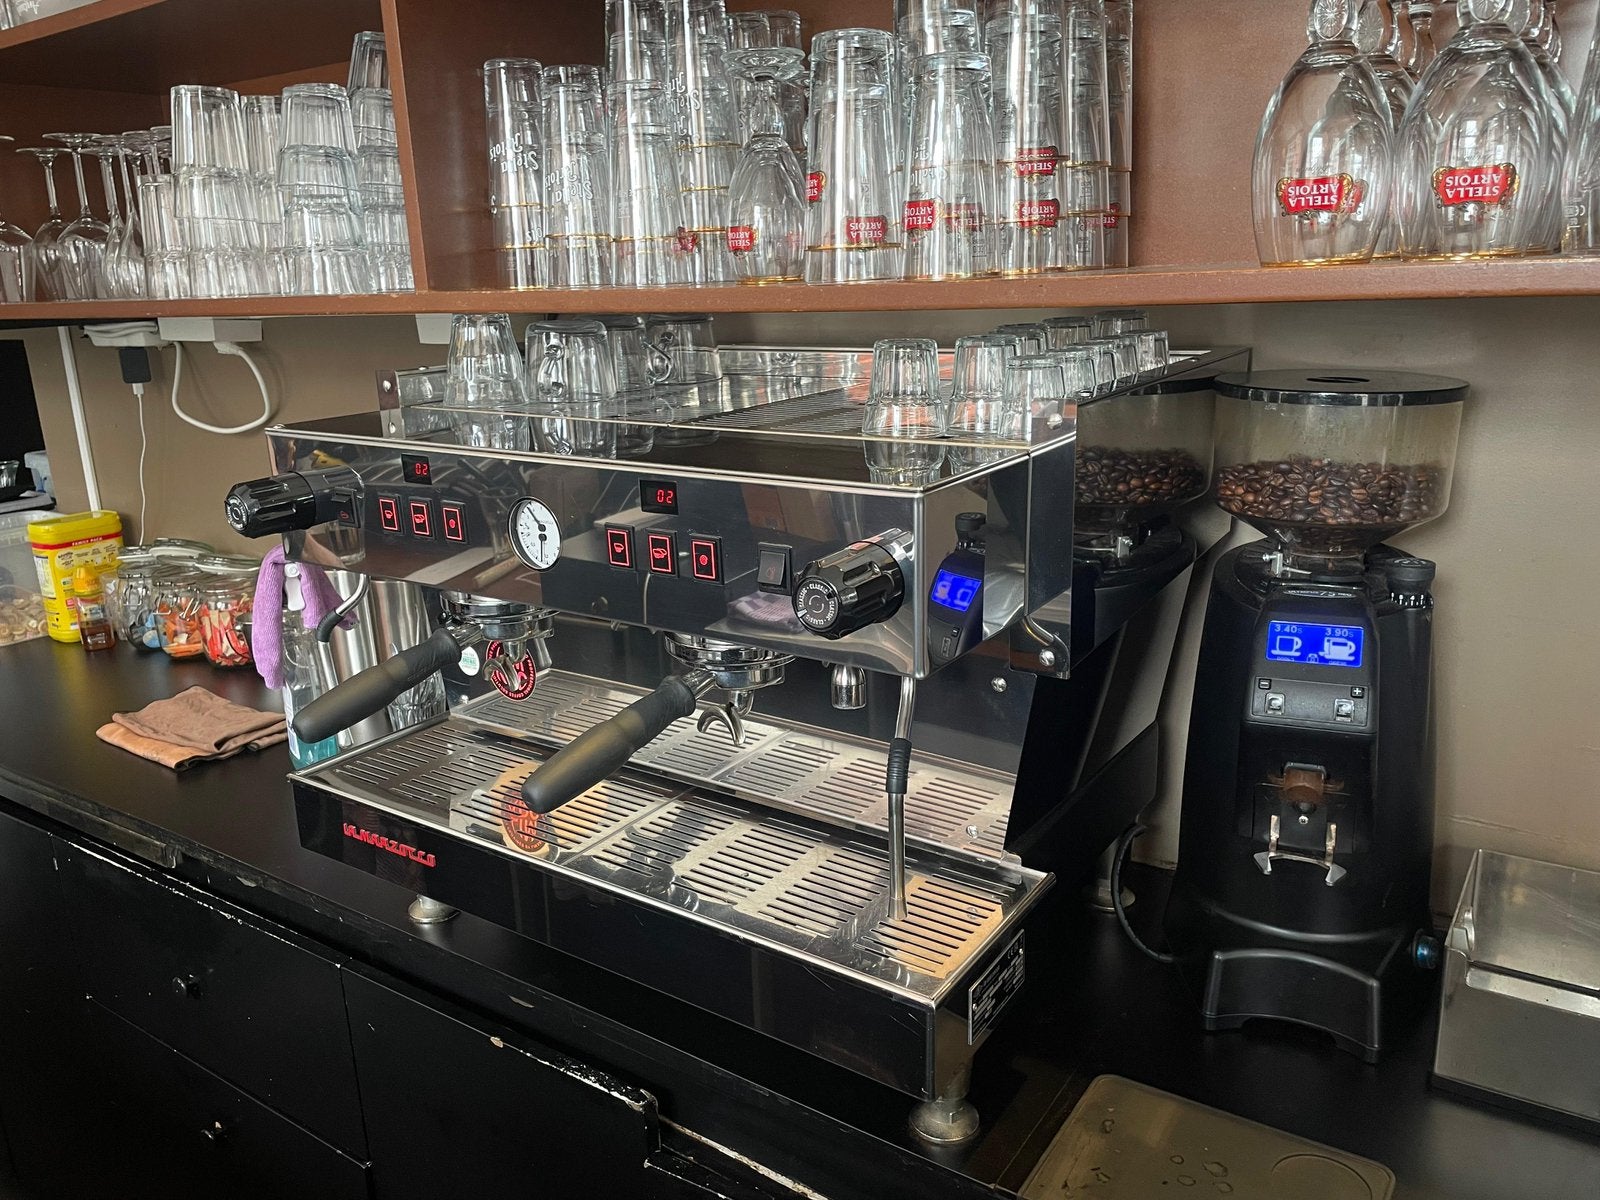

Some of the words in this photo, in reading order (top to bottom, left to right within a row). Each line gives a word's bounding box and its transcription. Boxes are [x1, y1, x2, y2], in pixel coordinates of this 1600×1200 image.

[489, 132, 523, 161] Atois
[500, 151, 539, 173] Stela
[1019, 162, 1053, 171] STELLA
[1445, 172, 1502, 187] ARTOIS
[1287, 181, 1340, 196] ARTOIS
[1445, 185, 1500, 199] STELLA
[1287, 194, 1339, 208] STELLA
[850, 222, 882, 231] ARTOIS
[727, 231, 750, 239] ARTO
[850, 230, 883, 239] STELLA
[415, 463, 428, 475] 02
[657, 489, 674, 504] 02
